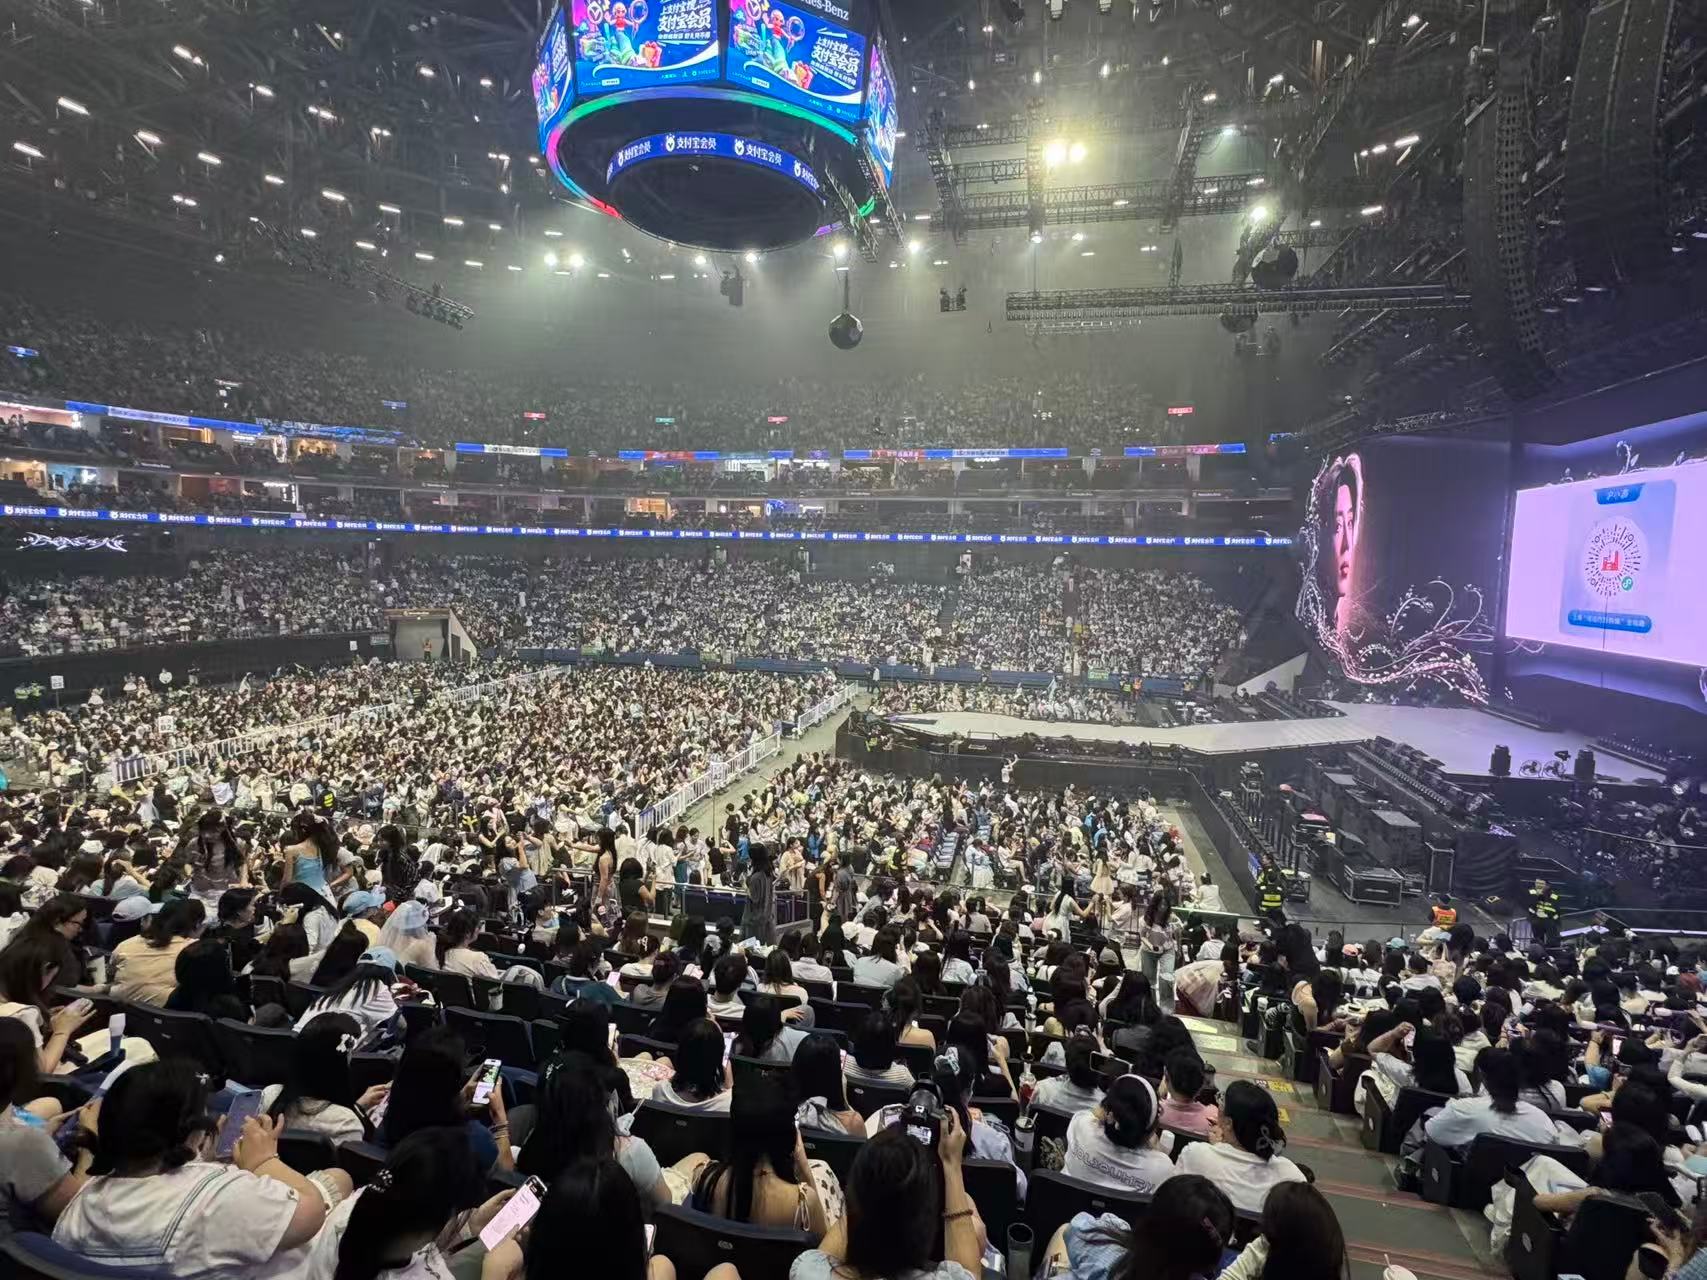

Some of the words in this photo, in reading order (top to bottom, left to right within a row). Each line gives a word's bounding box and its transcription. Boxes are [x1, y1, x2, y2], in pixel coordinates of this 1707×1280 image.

[657, 8, 711, 32] 支付宝会员
[811, 45, 860, 78] 支付宝会员
[623, 141, 651, 161] 支付宝会员
[676, 136, 717, 150] 支付宝会员
[746, 144, 782, 165] 支付宝会员
